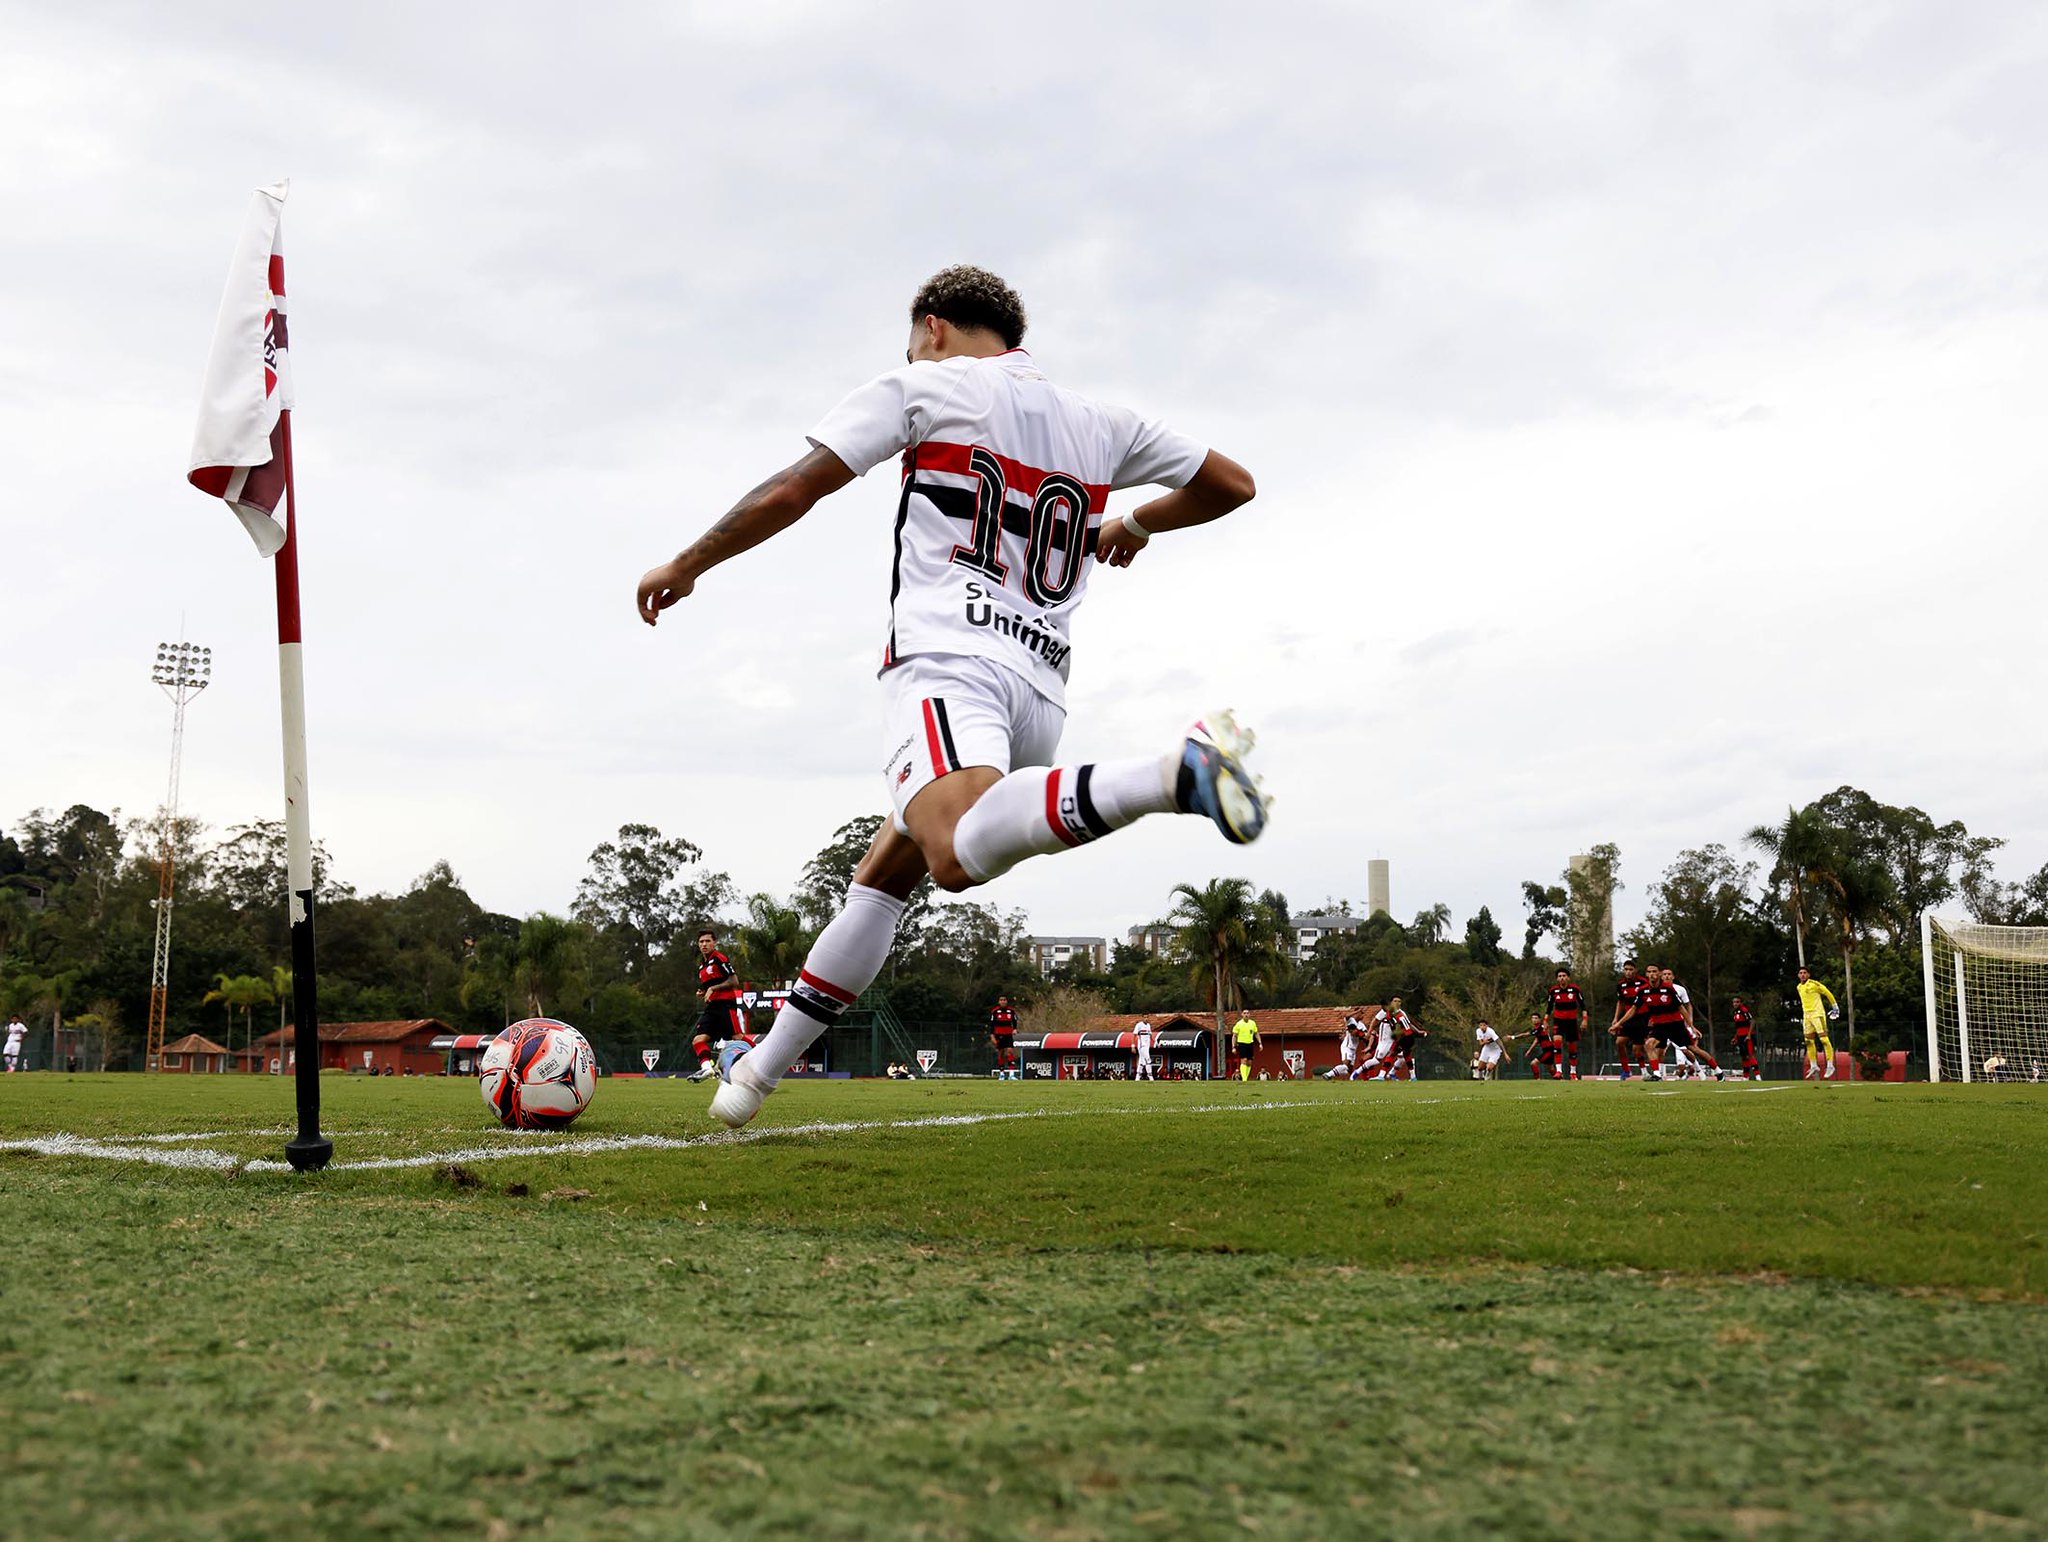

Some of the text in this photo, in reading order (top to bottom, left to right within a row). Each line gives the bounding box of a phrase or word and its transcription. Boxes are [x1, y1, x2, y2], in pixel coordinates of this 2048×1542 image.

[950, 445, 1091, 609] 10
[966, 602, 1071, 670] Unimed
[1065, 1057, 1086, 1065] SPFC
[1026, 1062, 1053, 1070] POWER
[1173, 1062, 1202, 1070] POWER
